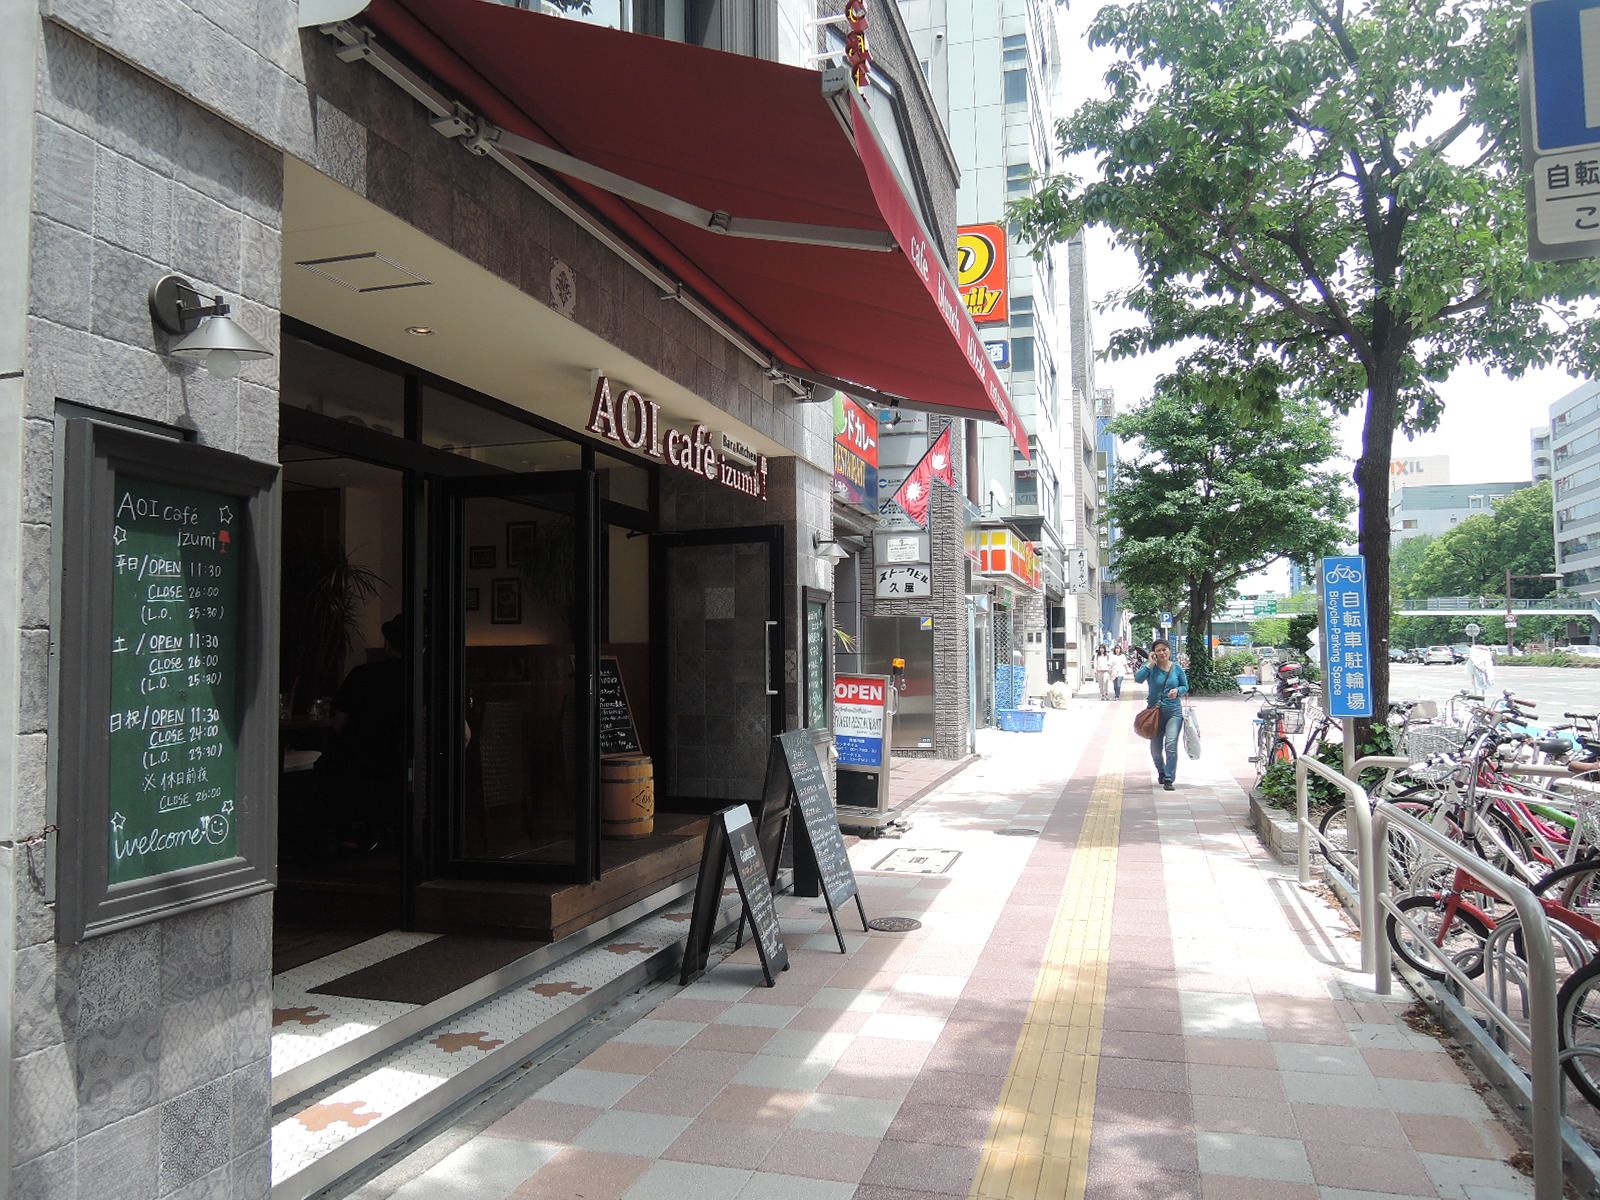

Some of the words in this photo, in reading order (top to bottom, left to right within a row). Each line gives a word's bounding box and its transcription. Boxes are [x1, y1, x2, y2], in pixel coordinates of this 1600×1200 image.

[586, 376, 661, 457] AOI
[719, 454, 757, 497] izumi
[1390, 461, 1424, 475] IXIL
[117, 492, 160, 521] AOI
[190, 561, 221, 578] 11:30
[879, 567, 929, 584] ストークビル
[147, 583, 185, 600] CLOSE
[1163, 613, 1170, 622] P
[149, 635, 183, 653] OPEN
[189, 633, 219, 649] 11:30
[1342, 591, 1365, 711] 自転車駐輪場
[1331, 665, 1343, 696] Space
[835, 683, 882, 701] OPEN
[191, 707, 220, 723] 11:30
[148, 728, 186, 750] CLOSE
[189, 724, 219, 742] 24:00
[158, 792, 191, 813] CLOSE
